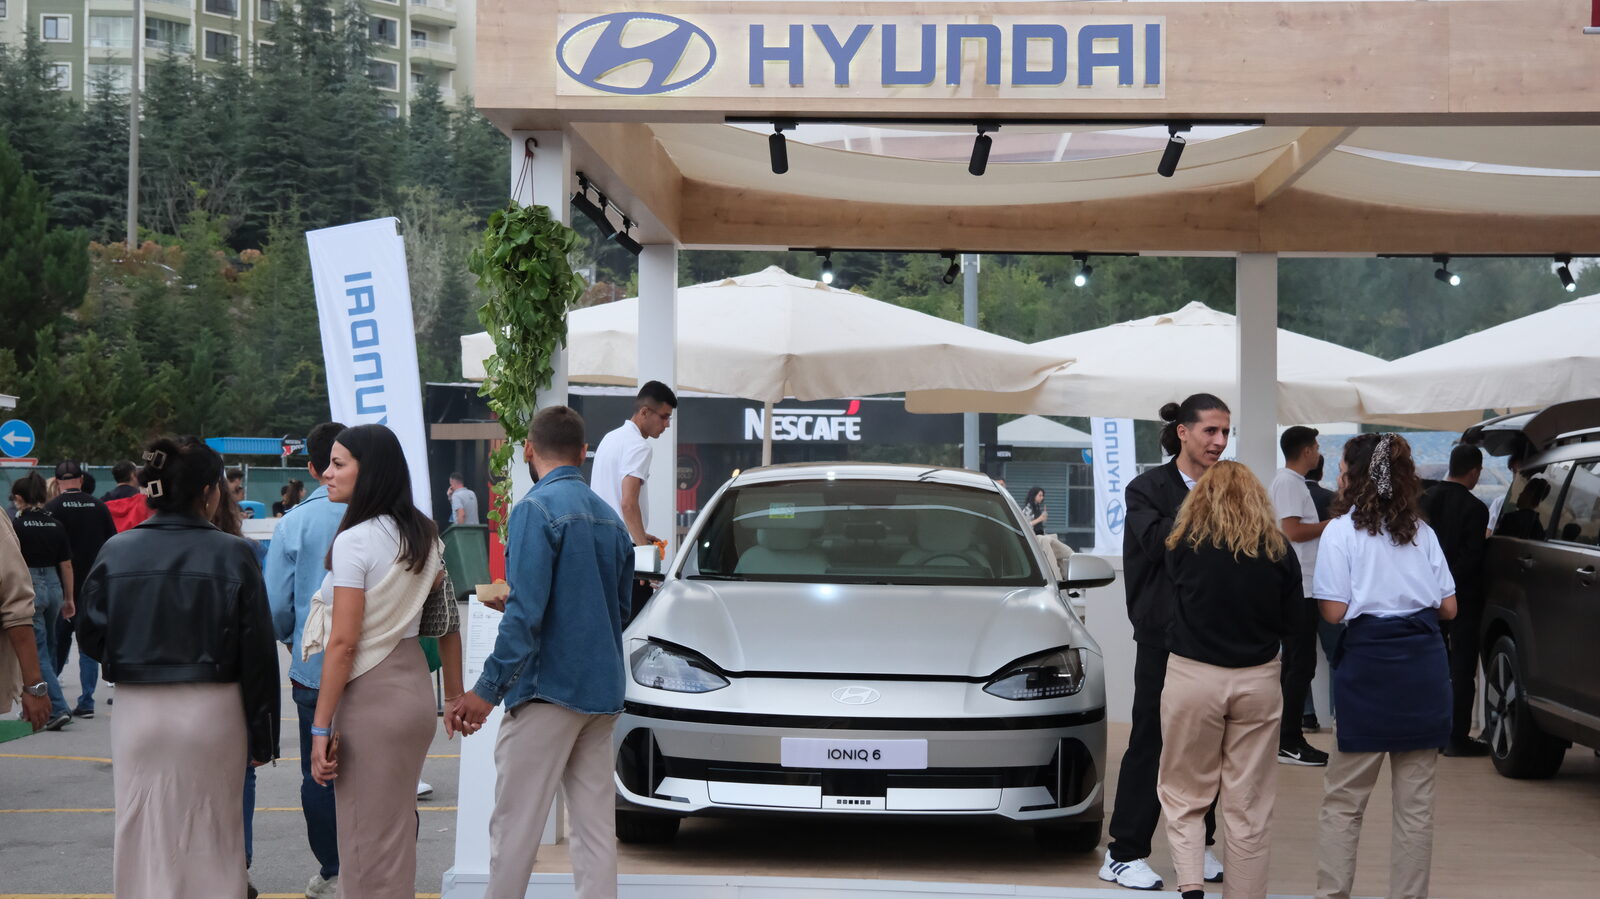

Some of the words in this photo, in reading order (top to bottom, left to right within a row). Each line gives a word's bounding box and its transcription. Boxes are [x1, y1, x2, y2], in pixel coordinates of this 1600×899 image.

[749, 24, 1161, 86] HYUNDAI
[344, 271, 388, 425] UNDAI
[1104, 417, 1121, 493] HYUND
[827, 749, 868, 762] IONIQ
[872, 749, 881, 760] 6
